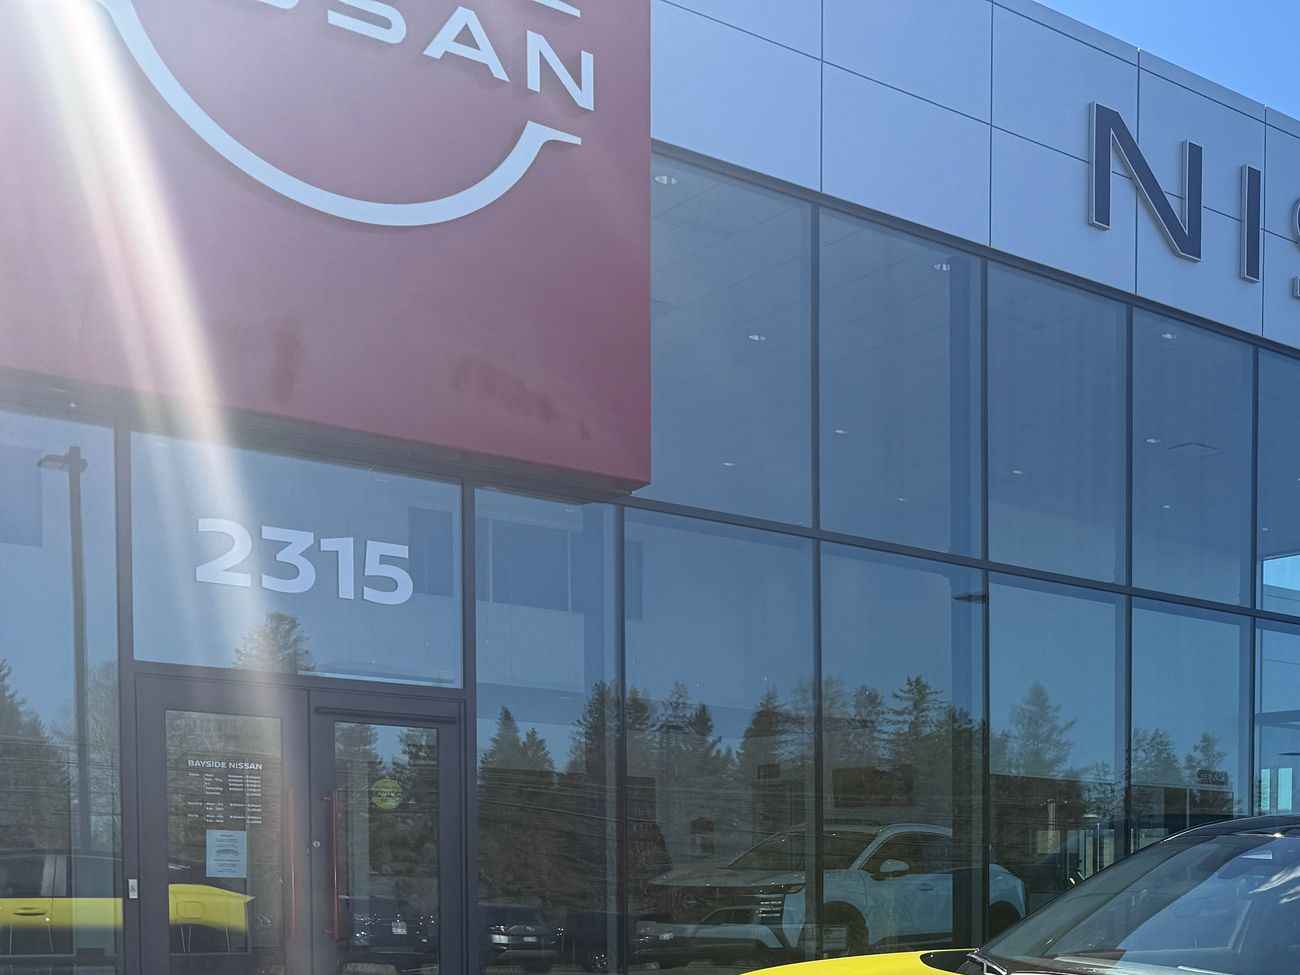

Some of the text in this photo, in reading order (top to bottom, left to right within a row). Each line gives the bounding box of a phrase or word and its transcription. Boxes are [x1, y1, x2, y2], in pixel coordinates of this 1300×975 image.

[257, 0, 594, 112] SAN
[194, 518, 415, 606] 2315
[188, 760, 263, 770] BAYSIDE NISSAN
